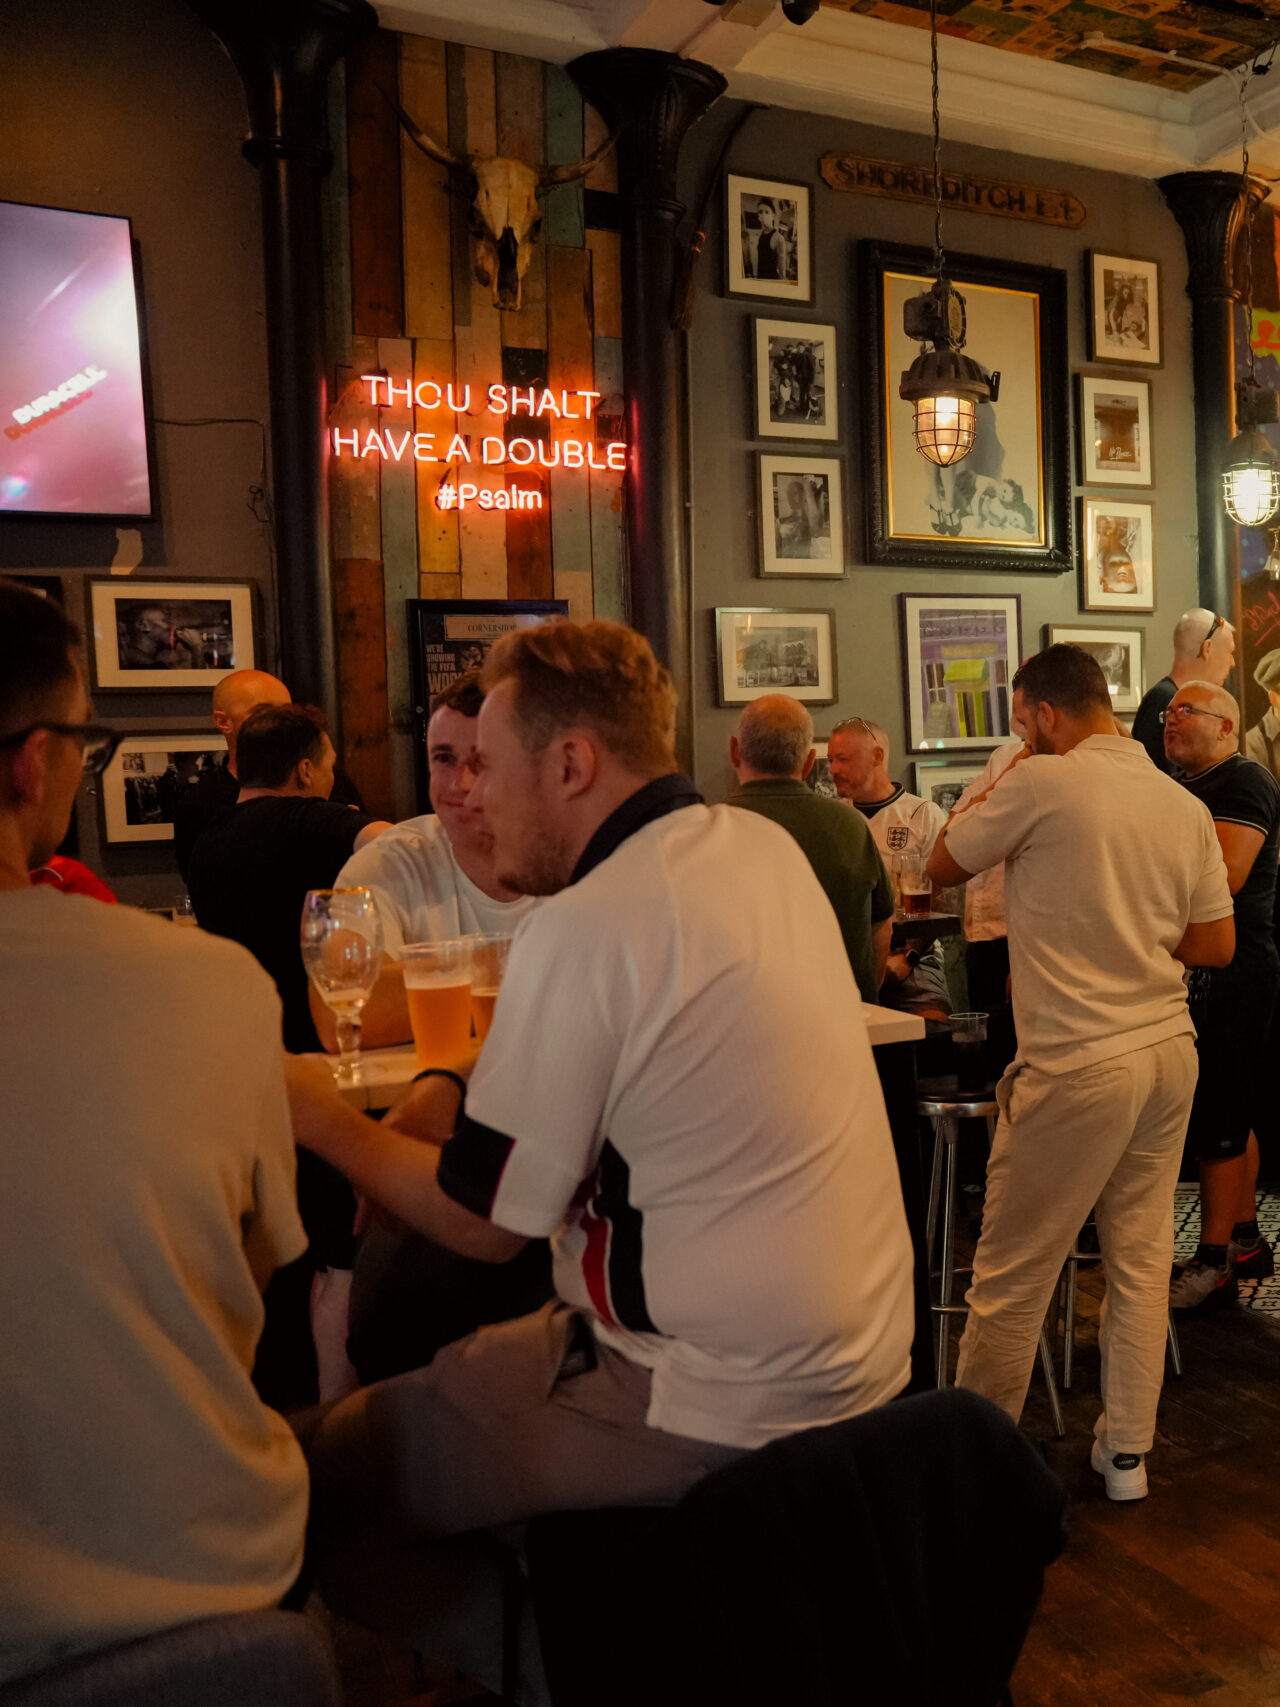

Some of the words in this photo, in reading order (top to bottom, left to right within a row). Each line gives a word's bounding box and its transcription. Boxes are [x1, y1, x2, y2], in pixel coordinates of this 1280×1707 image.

[361, 375, 471, 412] THOU
[488, 384, 601, 419] SHALT
[334, 428, 439, 462] HAVE
[446, 434, 472, 463] A
[482, 436, 628, 470] DOUBLE
[437, 483, 543, 509] #Psalm
